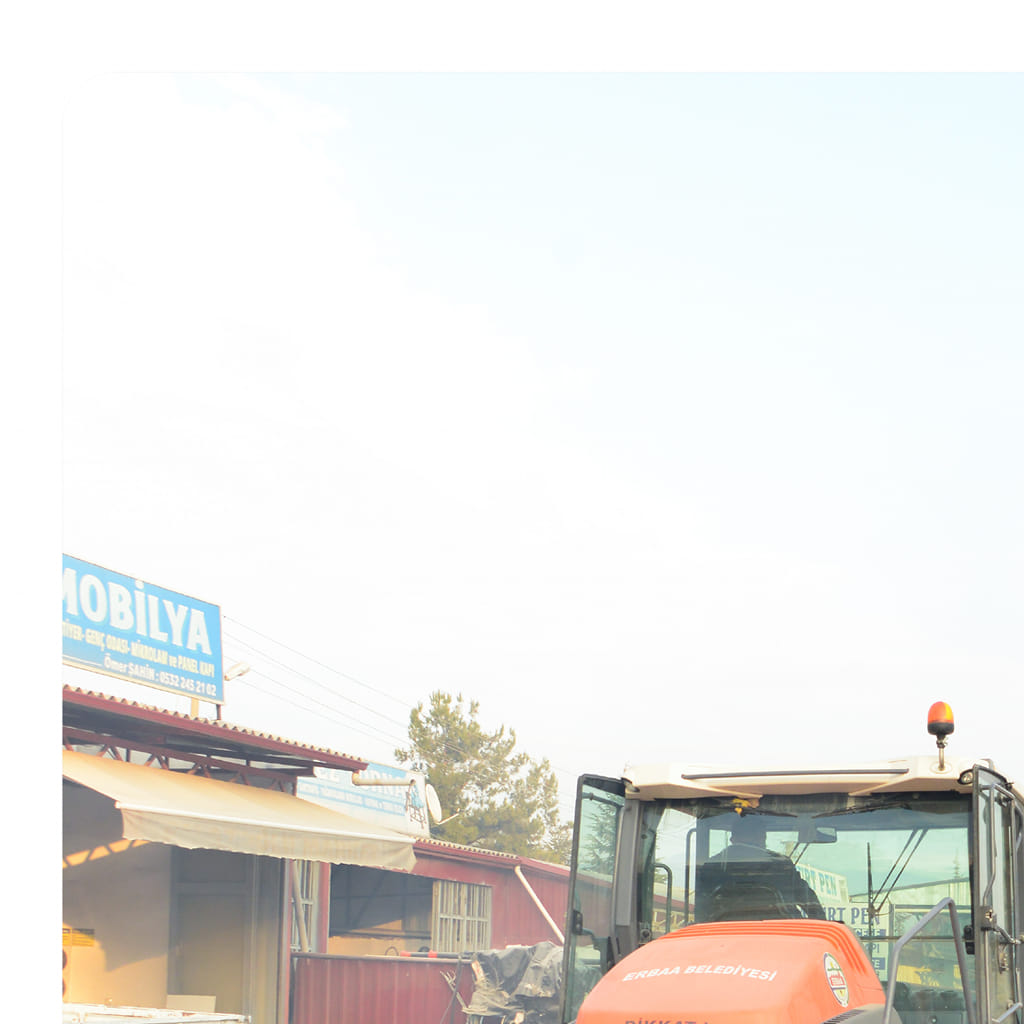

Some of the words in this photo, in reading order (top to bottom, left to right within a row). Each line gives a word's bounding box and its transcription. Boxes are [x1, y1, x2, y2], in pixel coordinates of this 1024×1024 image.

[103, 653, 128, 673] Ömer
[159, 671, 180, 688] 0532
[178, 655, 199, 674] PANEL
[199, 661, 215, 678] KAPI
[824, 906, 846, 921] RT
[622, 965, 681, 982] ERBAA
[684, 963, 778, 982] BELEDİYESİ
